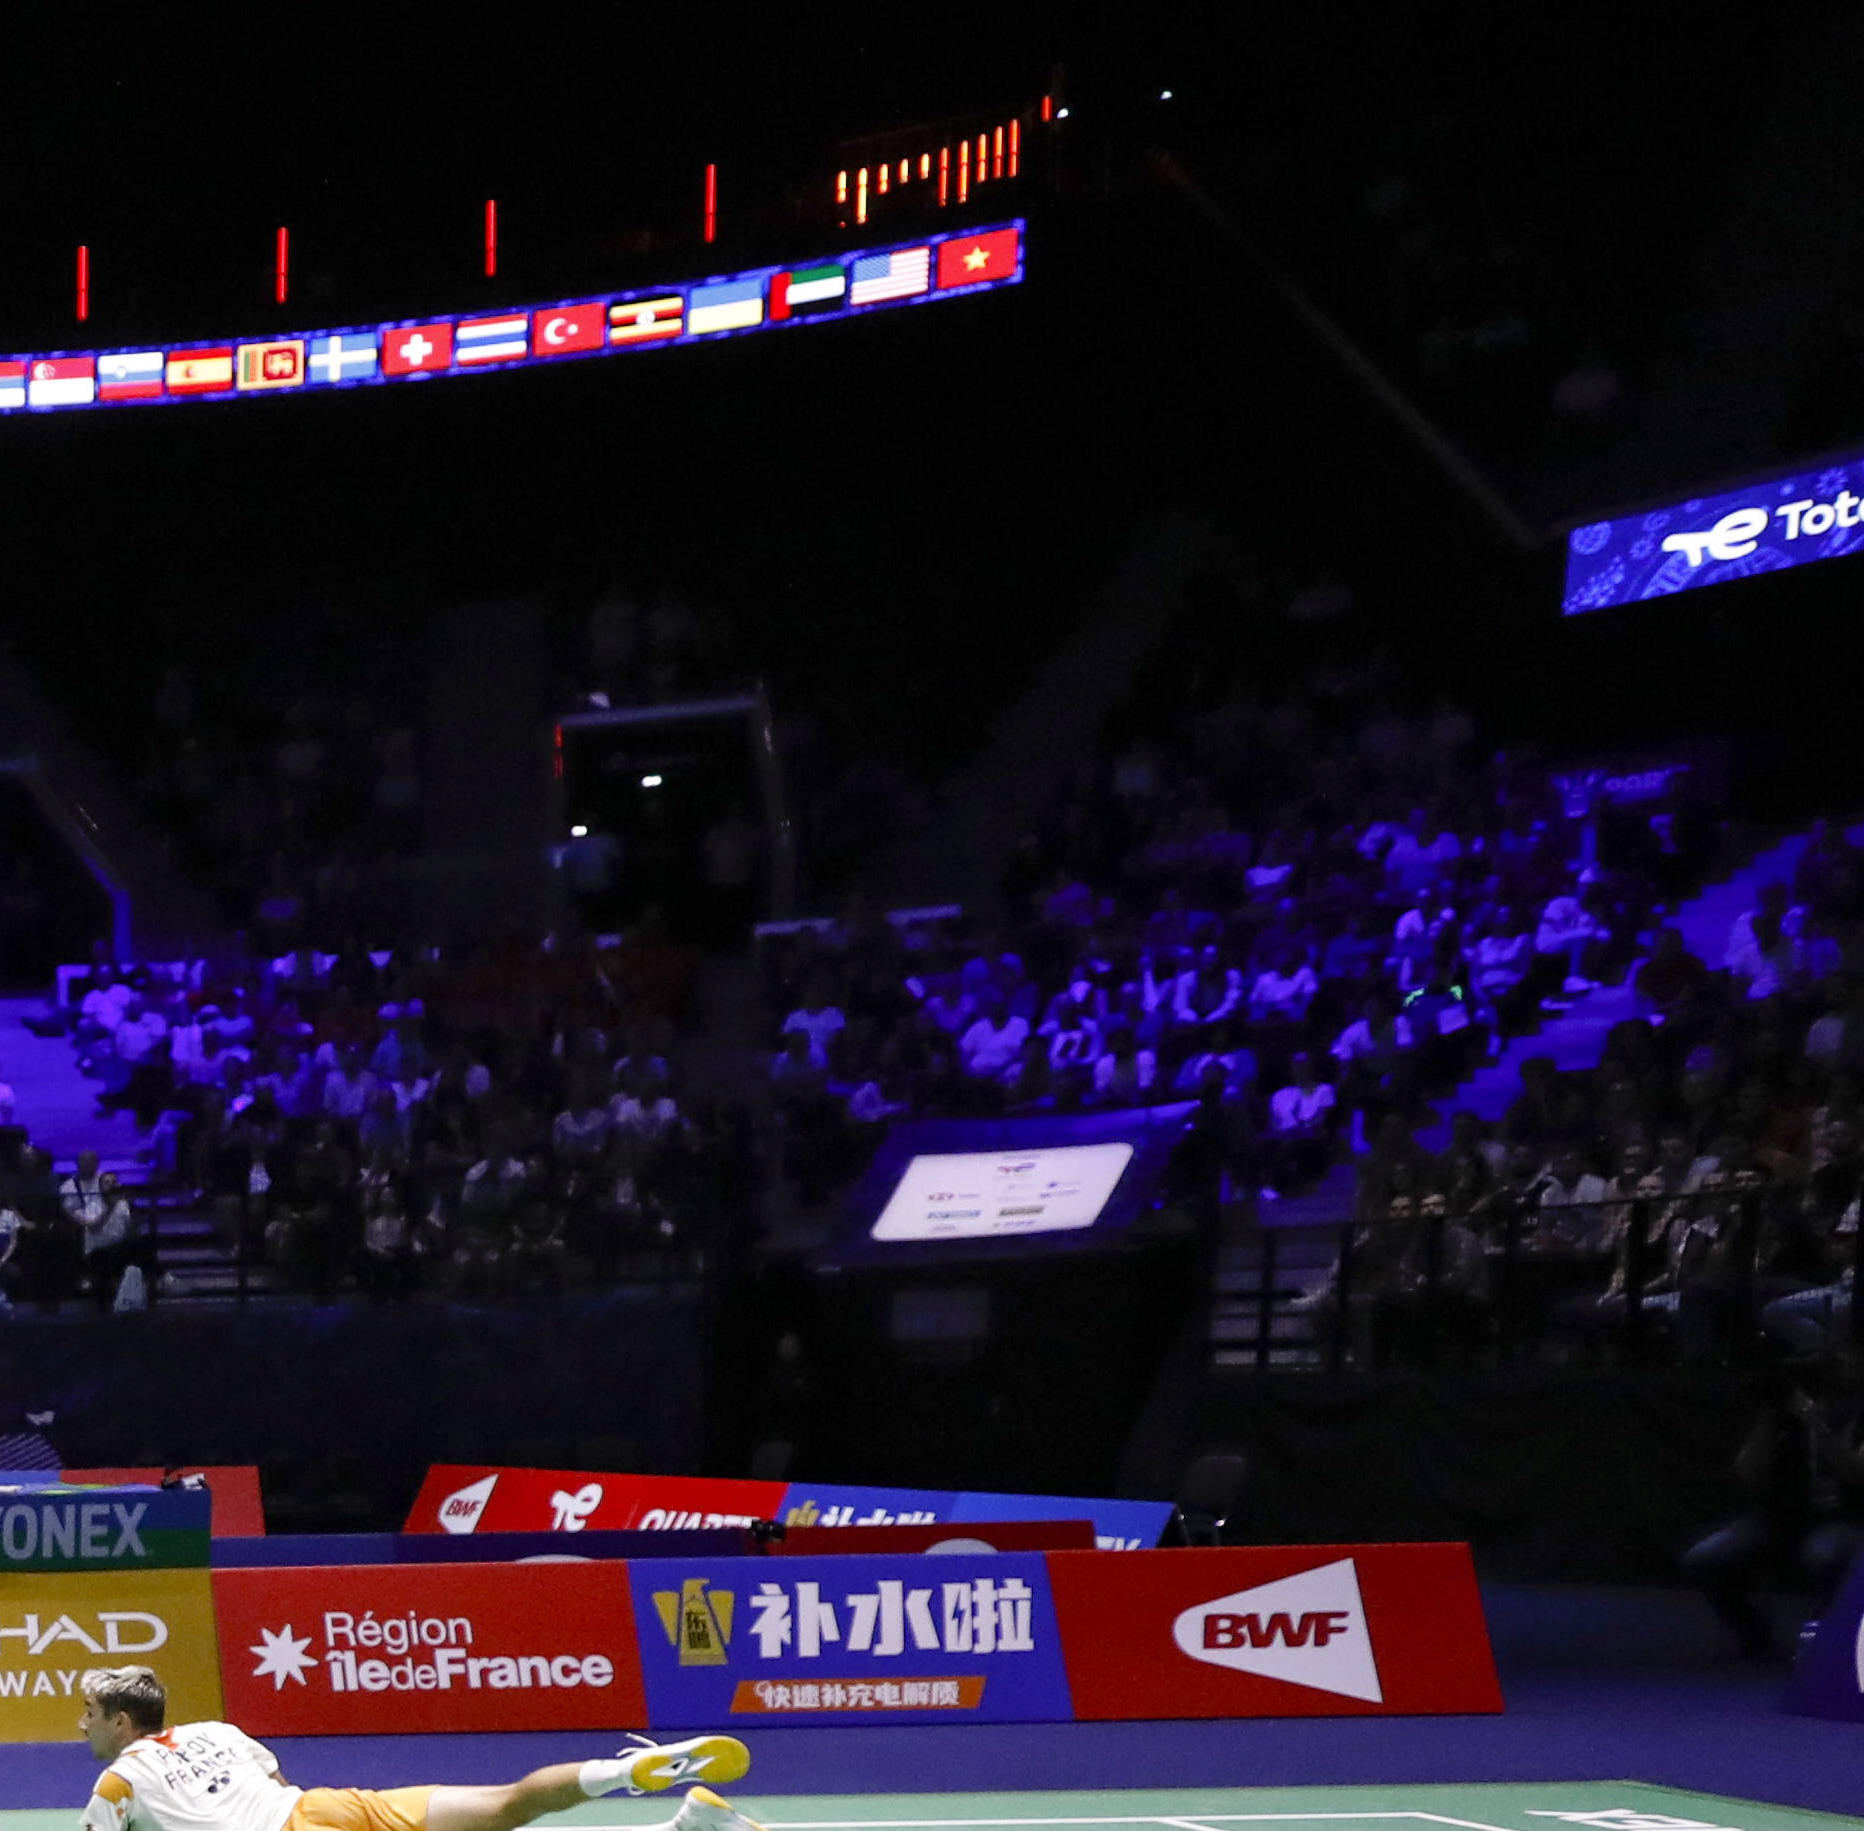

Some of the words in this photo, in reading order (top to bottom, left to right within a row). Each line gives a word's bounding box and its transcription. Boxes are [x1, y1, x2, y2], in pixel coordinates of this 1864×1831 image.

[1776, 491, 1864, 540] Tot
[445, 1498, 485, 1517] BWF
[324, 1610, 473, 1655] Région
[749, 1578, 1035, 1659] 补水啦
[1202, 1611, 1350, 1650] BWF
